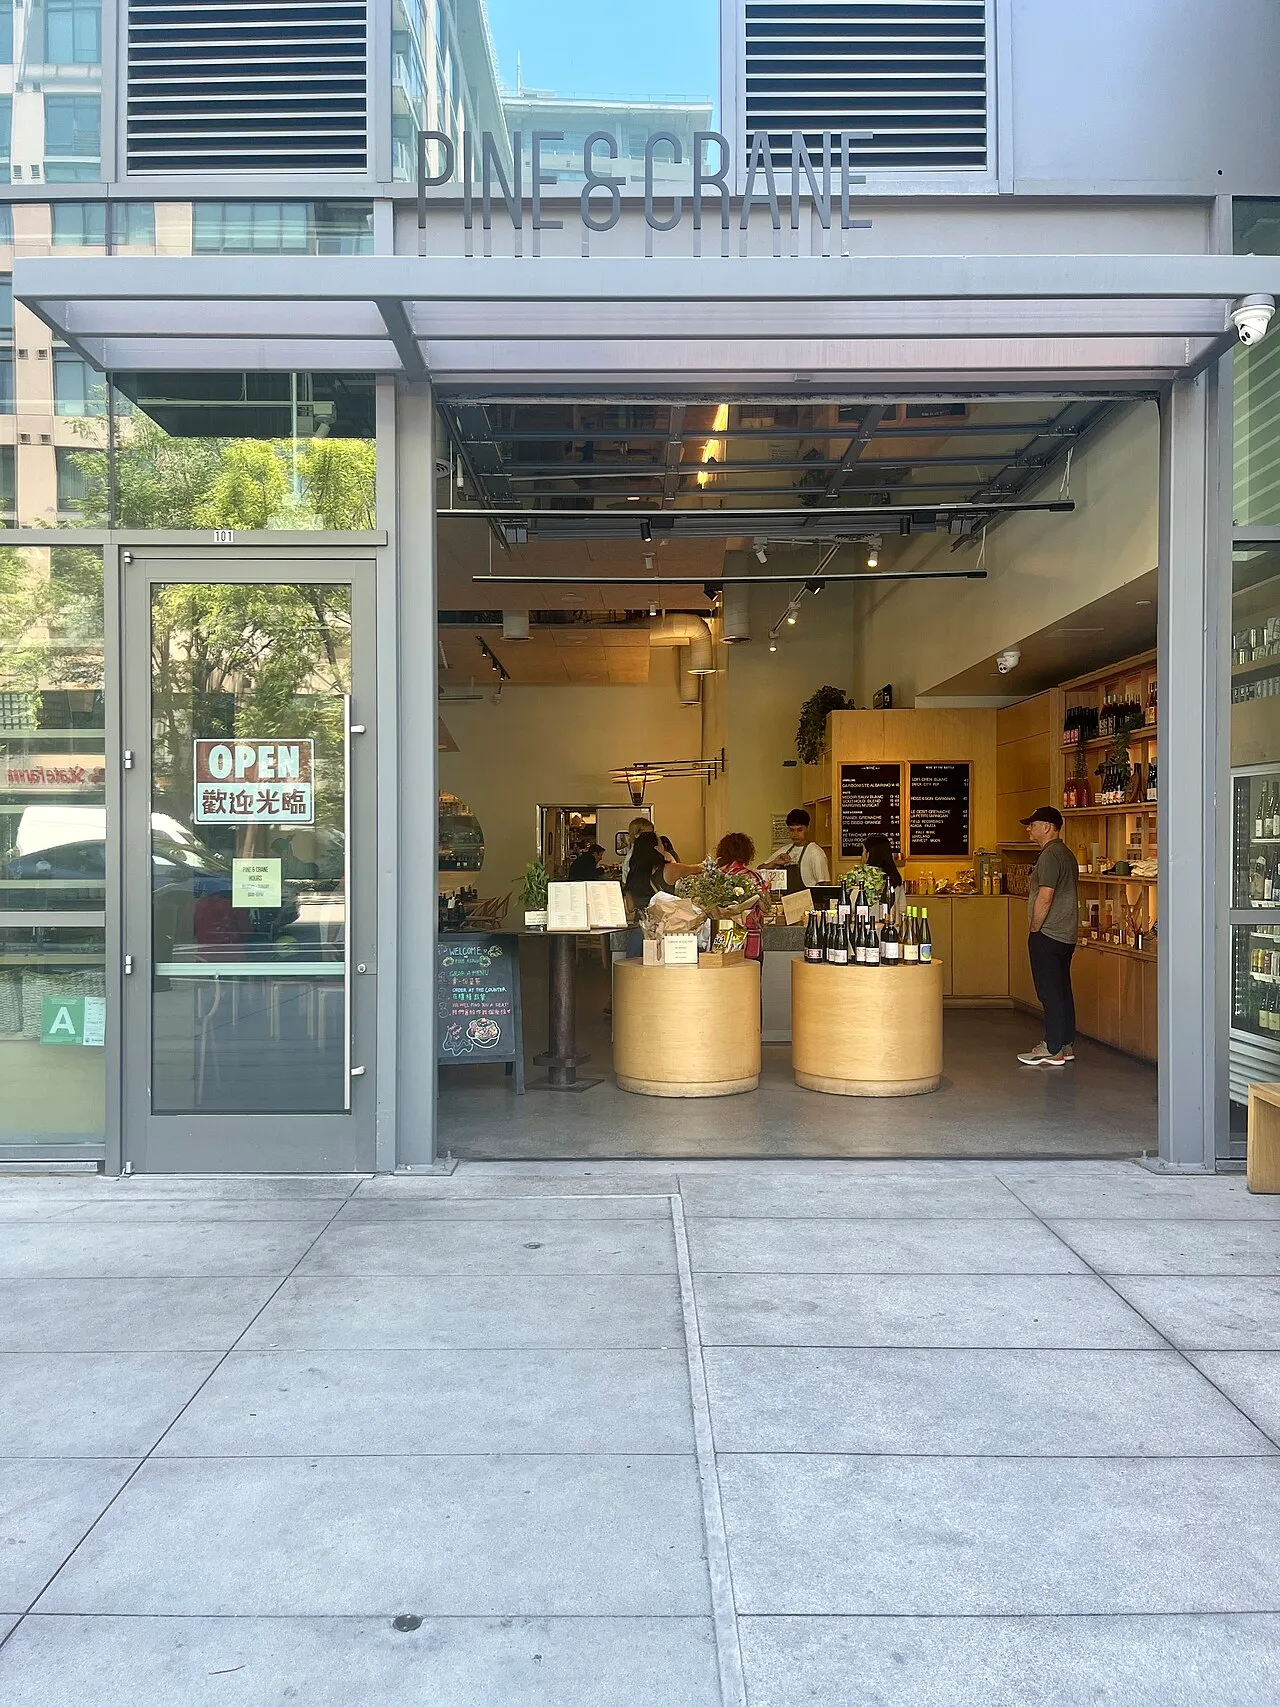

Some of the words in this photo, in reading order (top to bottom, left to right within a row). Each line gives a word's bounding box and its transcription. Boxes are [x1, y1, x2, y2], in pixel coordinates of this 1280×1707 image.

[418, 131, 564, 229] PINE
[581, 131, 627, 231] &
[645, 131, 873, 231] CRANE
[215, 530, 232, 542] 101
[208, 744, 300, 780] OPEN
[202, 788, 306, 815] 歡迎光臨
[448, 946, 483, 956] WELCOME
[471, 969, 490, 977] MENU
[49, 1006, 76, 1034] A
